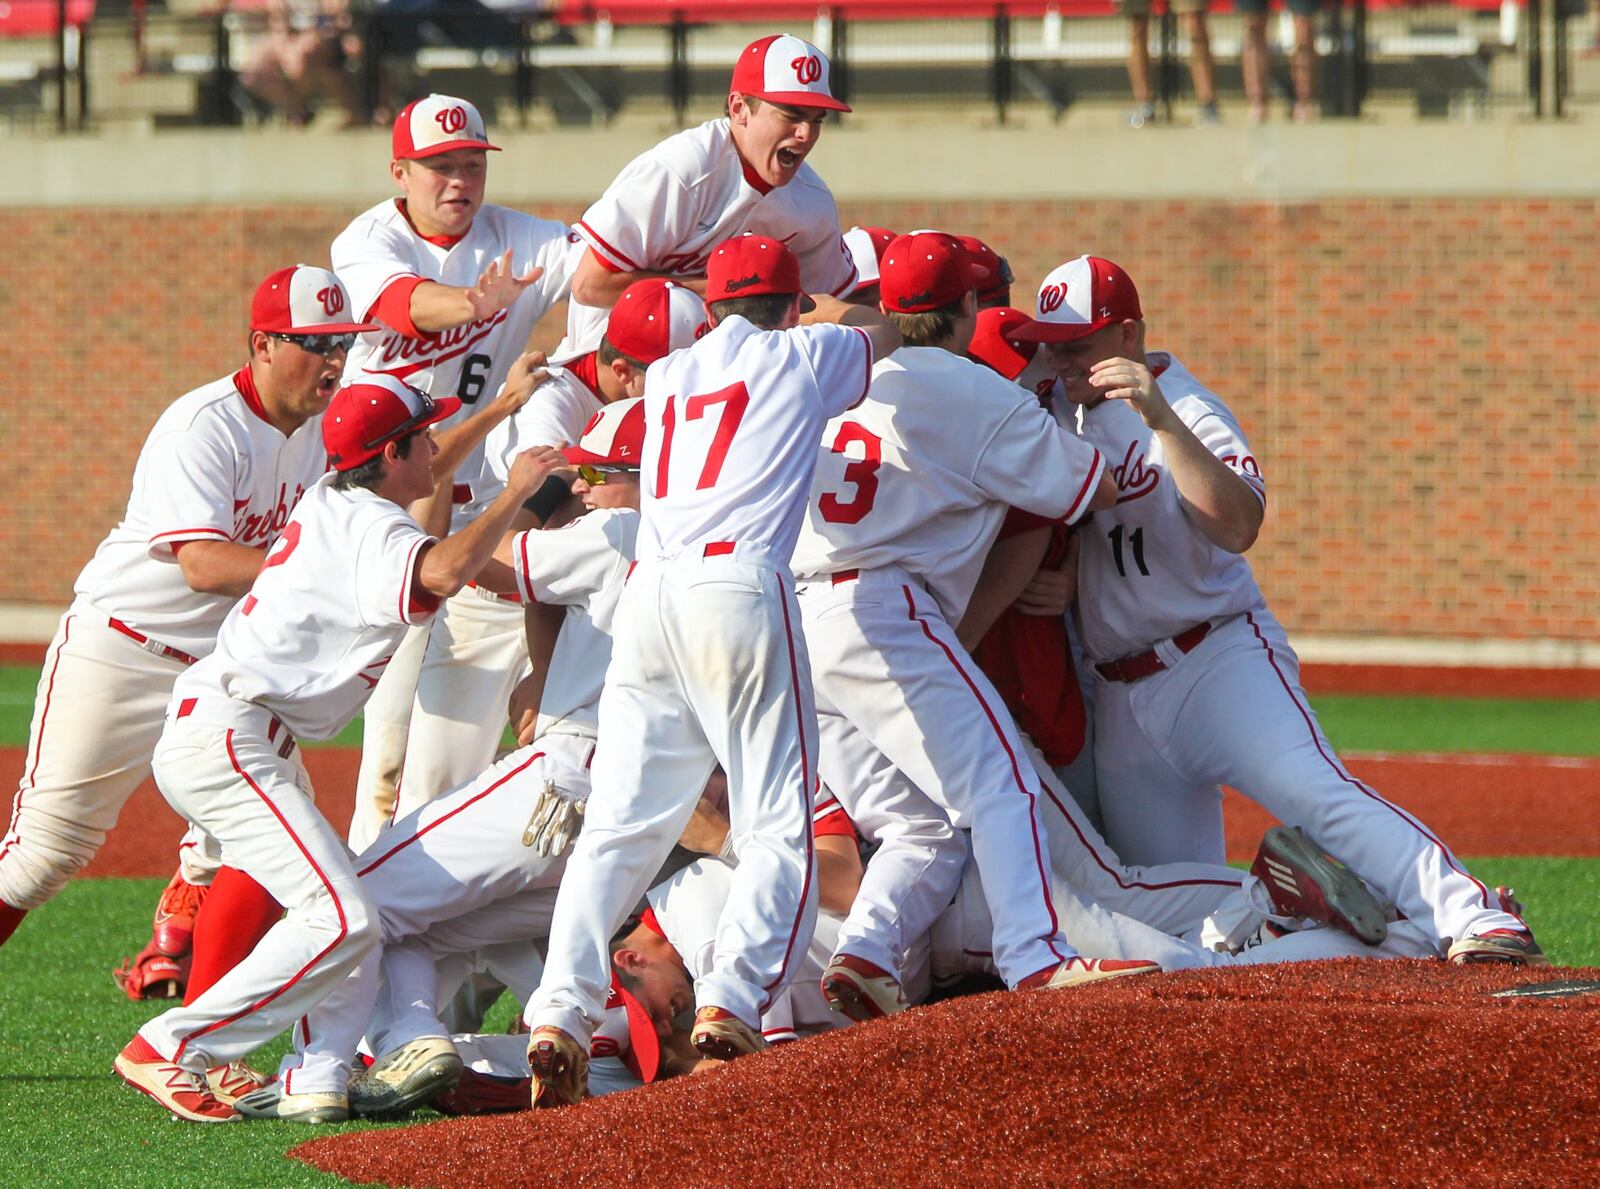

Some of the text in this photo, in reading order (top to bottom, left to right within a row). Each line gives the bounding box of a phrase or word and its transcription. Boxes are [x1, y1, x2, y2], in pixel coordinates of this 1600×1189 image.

[790, 55, 823, 85] W
[434, 106, 468, 135] W
[316, 284, 345, 317] W
[1039, 282, 1068, 315] W
[457, 354, 492, 404] 6
[655, 380, 750, 499] 17
[818, 421, 882, 524] 3
[1108, 525, 1150, 577] 11
